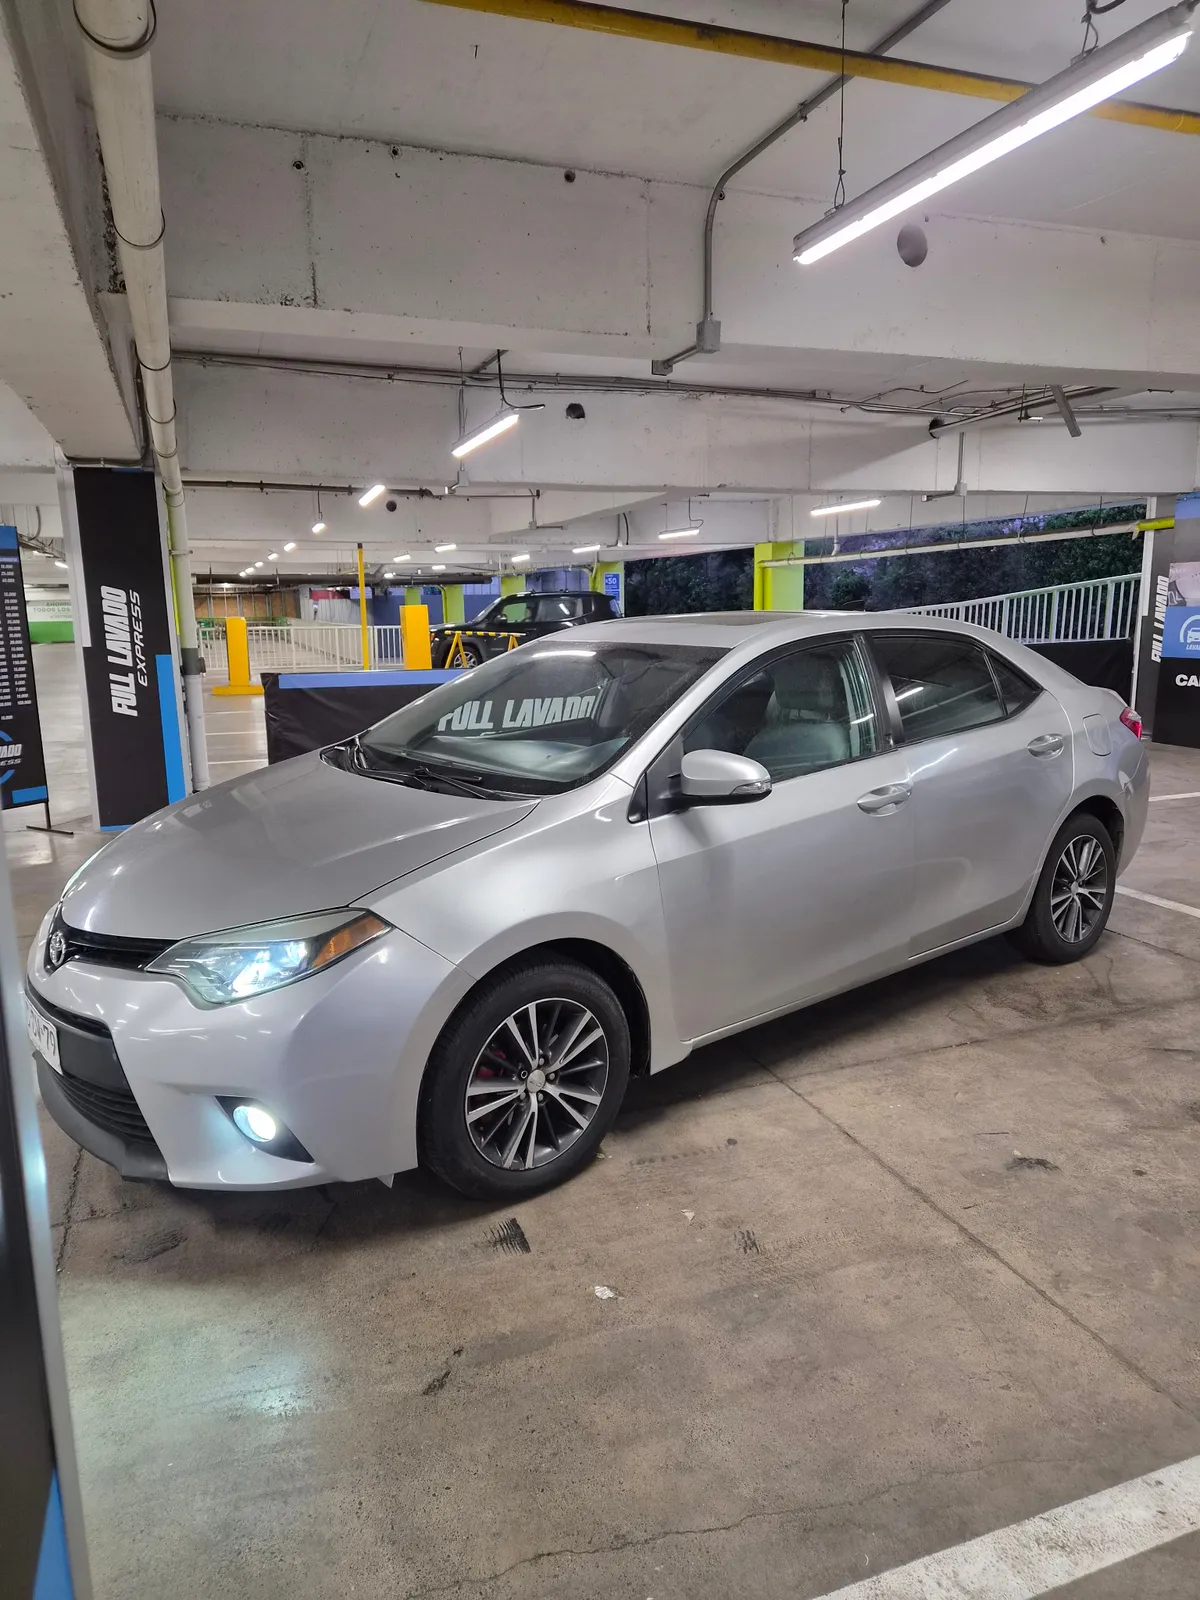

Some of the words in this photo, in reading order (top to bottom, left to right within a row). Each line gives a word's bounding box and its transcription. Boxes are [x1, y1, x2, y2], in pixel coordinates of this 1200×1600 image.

[100, 585, 133, 667] LAVADO
[129, 589, 148, 687] EXPRESS
[109, 672, 138, 717] FULL
[1175, 674, 1200, 687] CA
[502, 696, 595, 728] LAVADO
